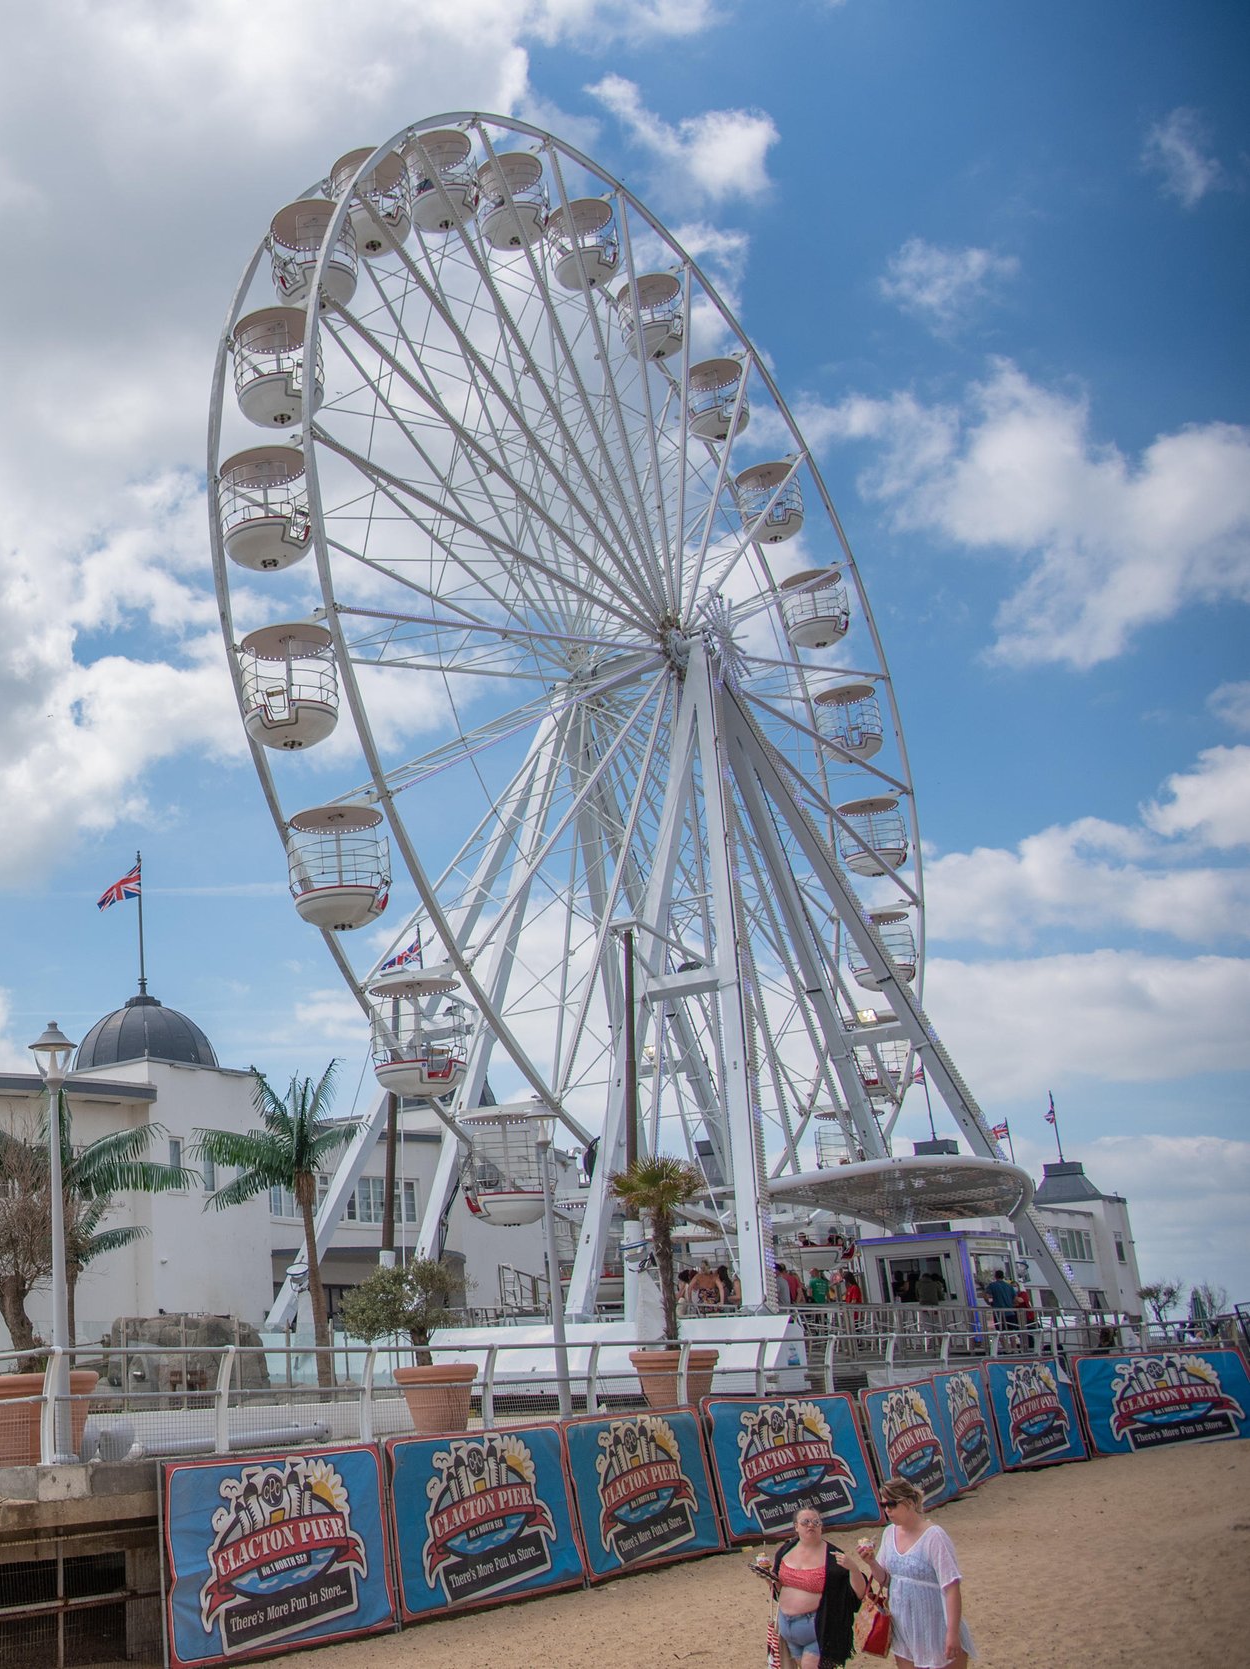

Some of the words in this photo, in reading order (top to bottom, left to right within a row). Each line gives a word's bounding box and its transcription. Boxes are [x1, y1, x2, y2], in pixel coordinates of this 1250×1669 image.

[1120, 1389, 1181, 1414] CLACTON
[1182, 1385, 1218, 1400] PIER
[890, 1431, 916, 1464] CLACTON
[914, 1426, 934, 1443] PIER
[1135, 1432, 1161, 1442] There's
[1162, 1428, 1180, 1438] More
[1180, 1425, 1195, 1434] Fun
[745, 1447, 796, 1479] CLACTON
[796, 1444, 830, 1460] PIER
[604, 1469, 649, 1508] CLACTON
[650, 1464, 680, 1483] PIER
[434, 1493, 496, 1538] CLACTON
[498, 1487, 533, 1510] PIER
[760, 1506, 783, 1520] There's
[783, 1501, 798, 1514] More
[812, 1494, 820, 1504] in
[479, 1522, 494, 1535] NORTH
[494, 1518, 504, 1528] SEA
[618, 1534, 638, 1552] There's
[638, 1530, 652, 1542] More
[650, 1524, 664, 1537] Fun
[662, 1522, 669, 1534] in
[217, 1524, 295, 1576] CLACTON
[299, 1517, 346, 1544] PIER
[261, 1564, 274, 1576] No.1
[276, 1556, 296, 1573] NORTH
[296, 1554, 308, 1566] SEA
[449, 1568, 477, 1588] There's
[477, 1562, 494, 1578] More
[494, 1554, 510, 1570] Fun
[510, 1552, 518, 1564] in
[230, 1610, 264, 1632] There's
[267, 1604, 290, 1620] More
[290, 1594, 308, 1610] Fun
[310, 1592, 318, 1606] in
